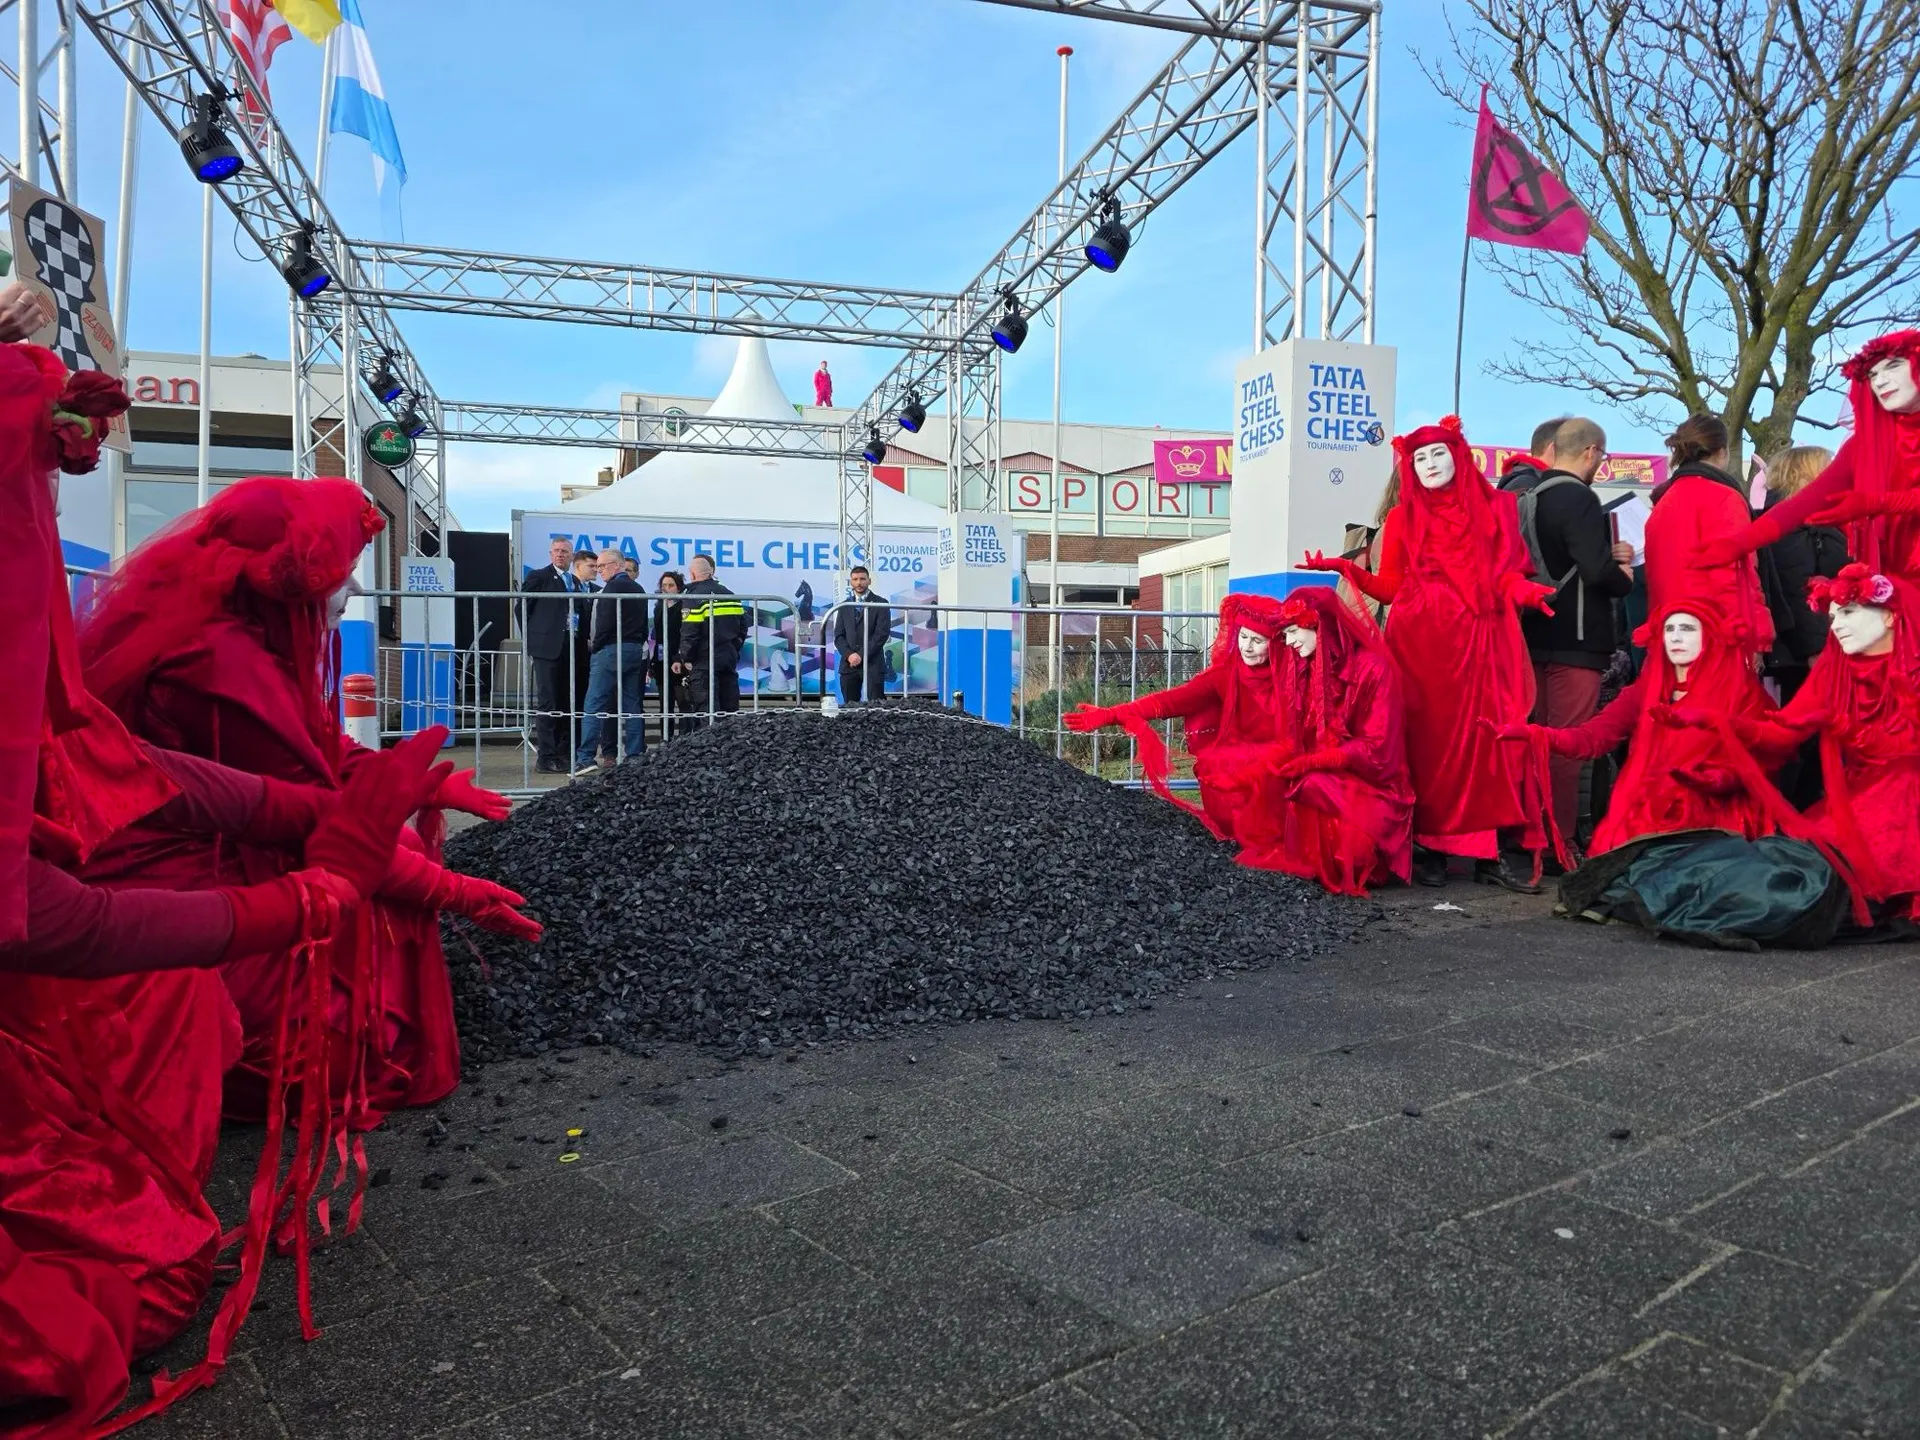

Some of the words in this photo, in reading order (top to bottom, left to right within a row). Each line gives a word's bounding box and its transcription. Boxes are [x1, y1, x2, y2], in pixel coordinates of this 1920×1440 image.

[1242, 372, 1275, 403] TATA
[1309, 364, 1367, 391] TATA
[120, 375, 201, 405] an
[1240, 395, 1281, 429] STEEL
[1308, 390, 1377, 418] STEEL
[1240, 418, 1285, 453] CHESS
[370, 444, 408, 454] Heineken
[1307, 441, 1359, 453] TOURNAMENT
[1018, 475, 1221, 514] SPORT
[965, 525, 997, 537] TATA
[650, 537, 755, 569] STEEL
[965, 538, 1003, 550] STEEL
[878, 556, 923, 572] 2026
[965, 551, 1006, 563] CHESS
[408, 565, 435, 575] TATA
[409, 576, 441, 585] STEEL
